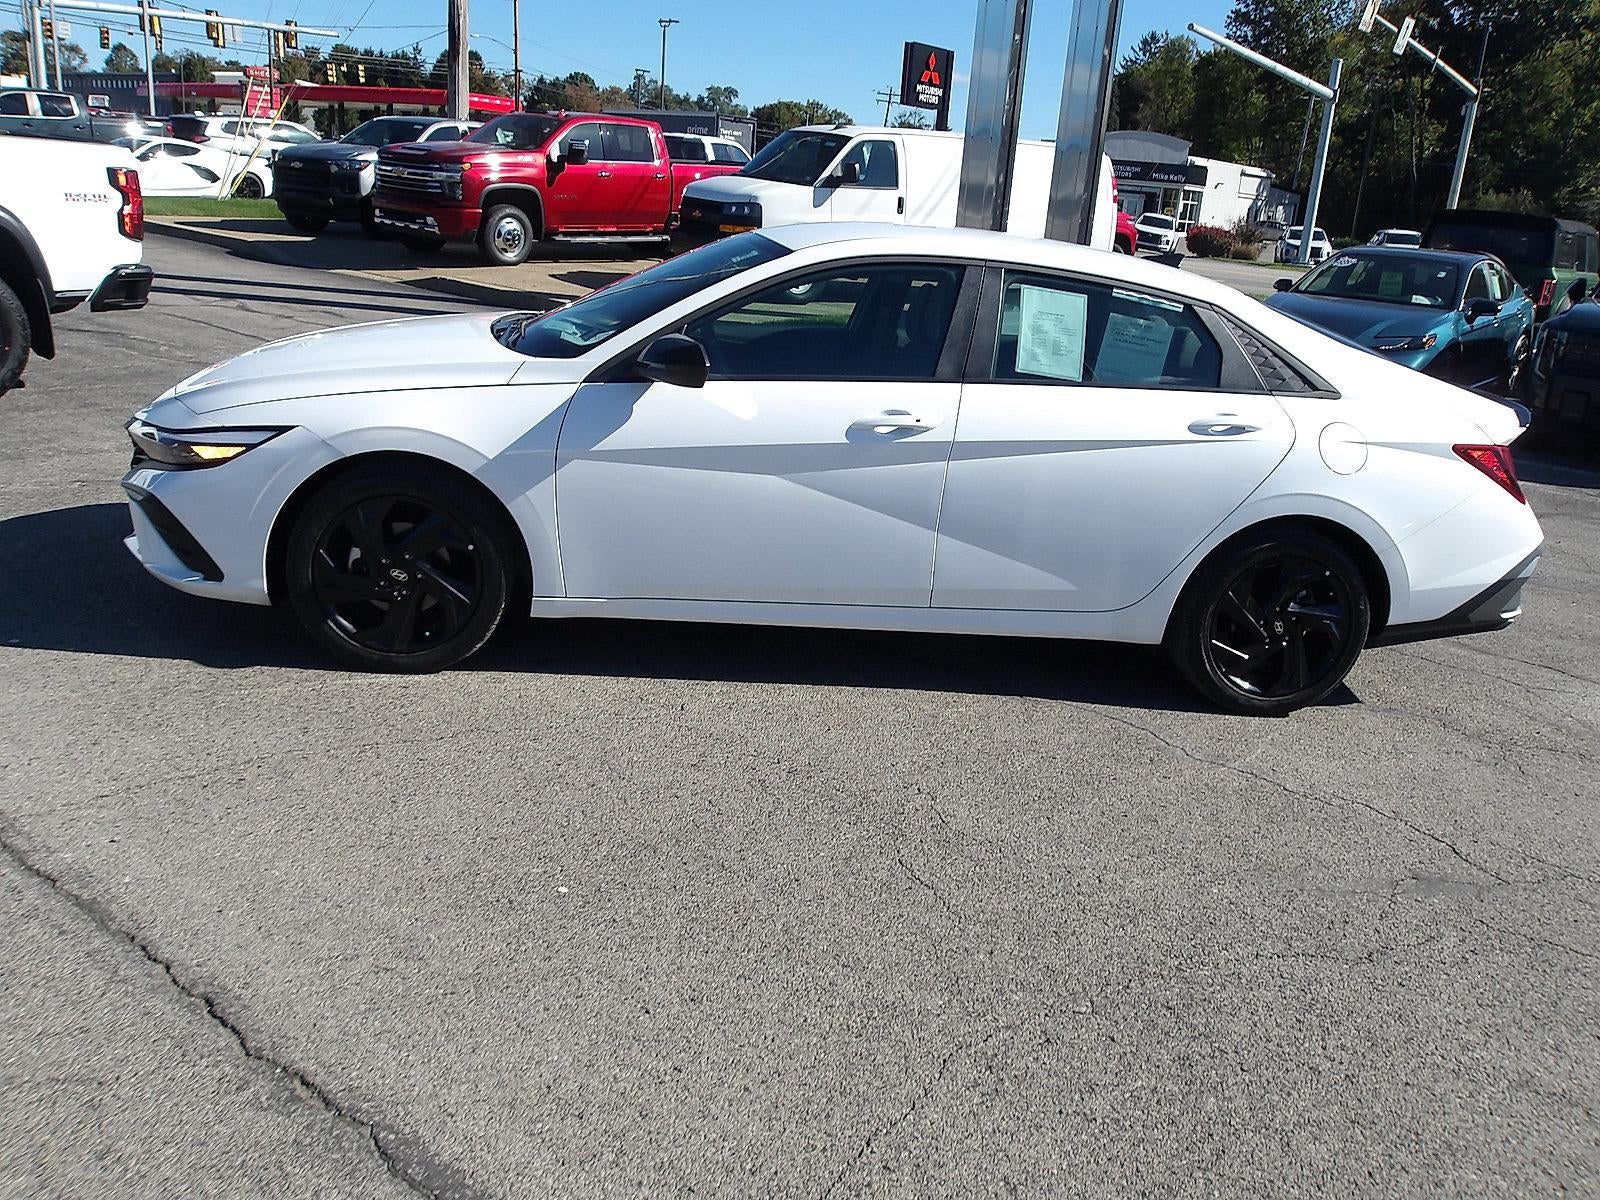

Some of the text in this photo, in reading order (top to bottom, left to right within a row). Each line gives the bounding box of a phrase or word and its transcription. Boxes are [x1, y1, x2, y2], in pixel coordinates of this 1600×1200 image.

[916, 83, 943, 96] MITSUBISHI
[918, 93, 939, 104] MOTORS
[1152, 172, 1187, 183] Mike Kelly
